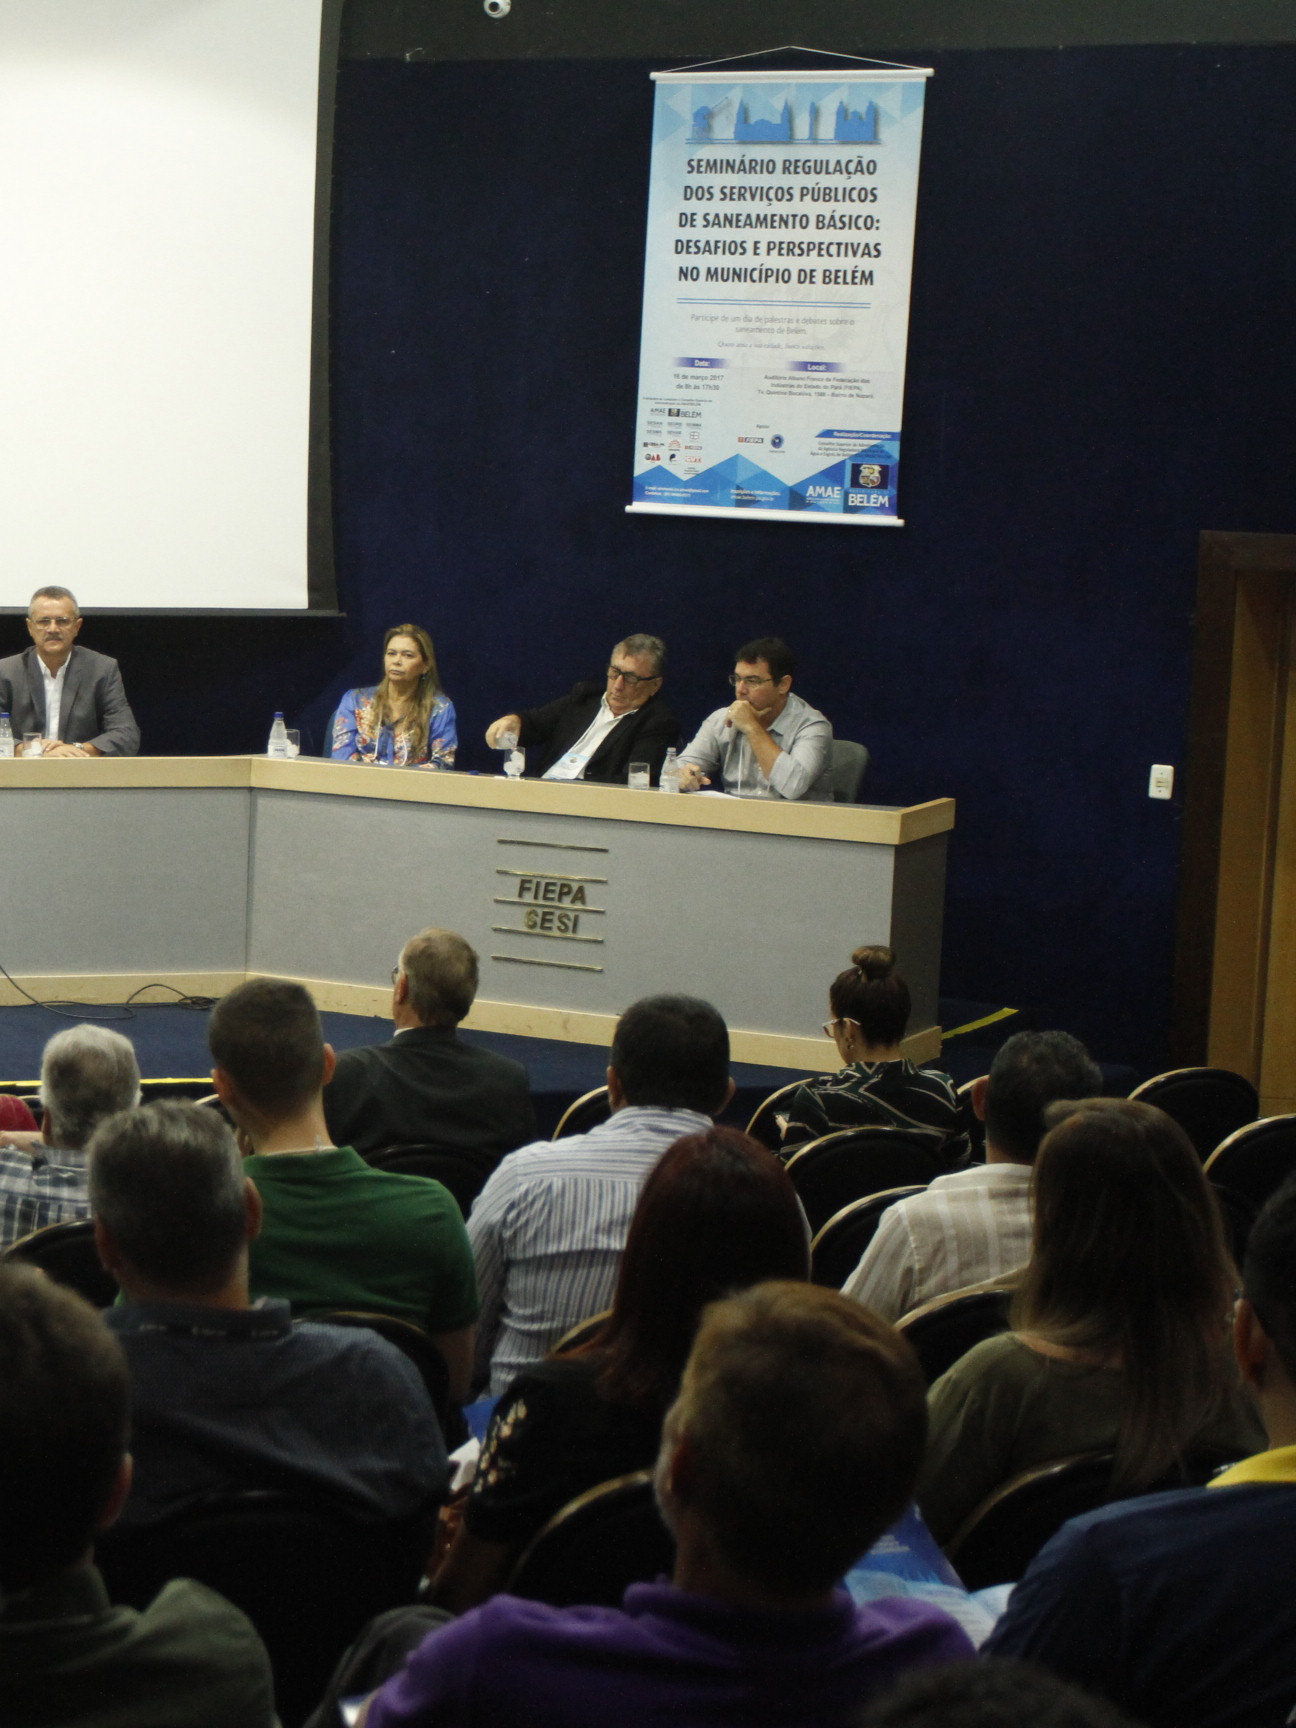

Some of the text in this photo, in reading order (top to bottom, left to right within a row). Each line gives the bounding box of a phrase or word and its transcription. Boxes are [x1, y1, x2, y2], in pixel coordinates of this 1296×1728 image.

[686, 155, 878, 180] SEMINÁRIO REGULAÇÃO
[683, 182, 878, 207] DOS SERVIÇOS PÚBLICOS
[678, 210, 881, 231] DE SANEAMENTO BÁSICO:
[674, 239, 882, 259] DESAFIOS E PERSPECTIVAS
[678, 263, 875, 286] NO MUNICÍPIO DE BELÉM
[807, 363, 827, 371] Local:
[805, 486, 842, 498] AMAE
[848, 493, 889, 507] BELÉM
[518, 879, 587, 906] FIEPA
[524, 909, 580, 934] SESI
